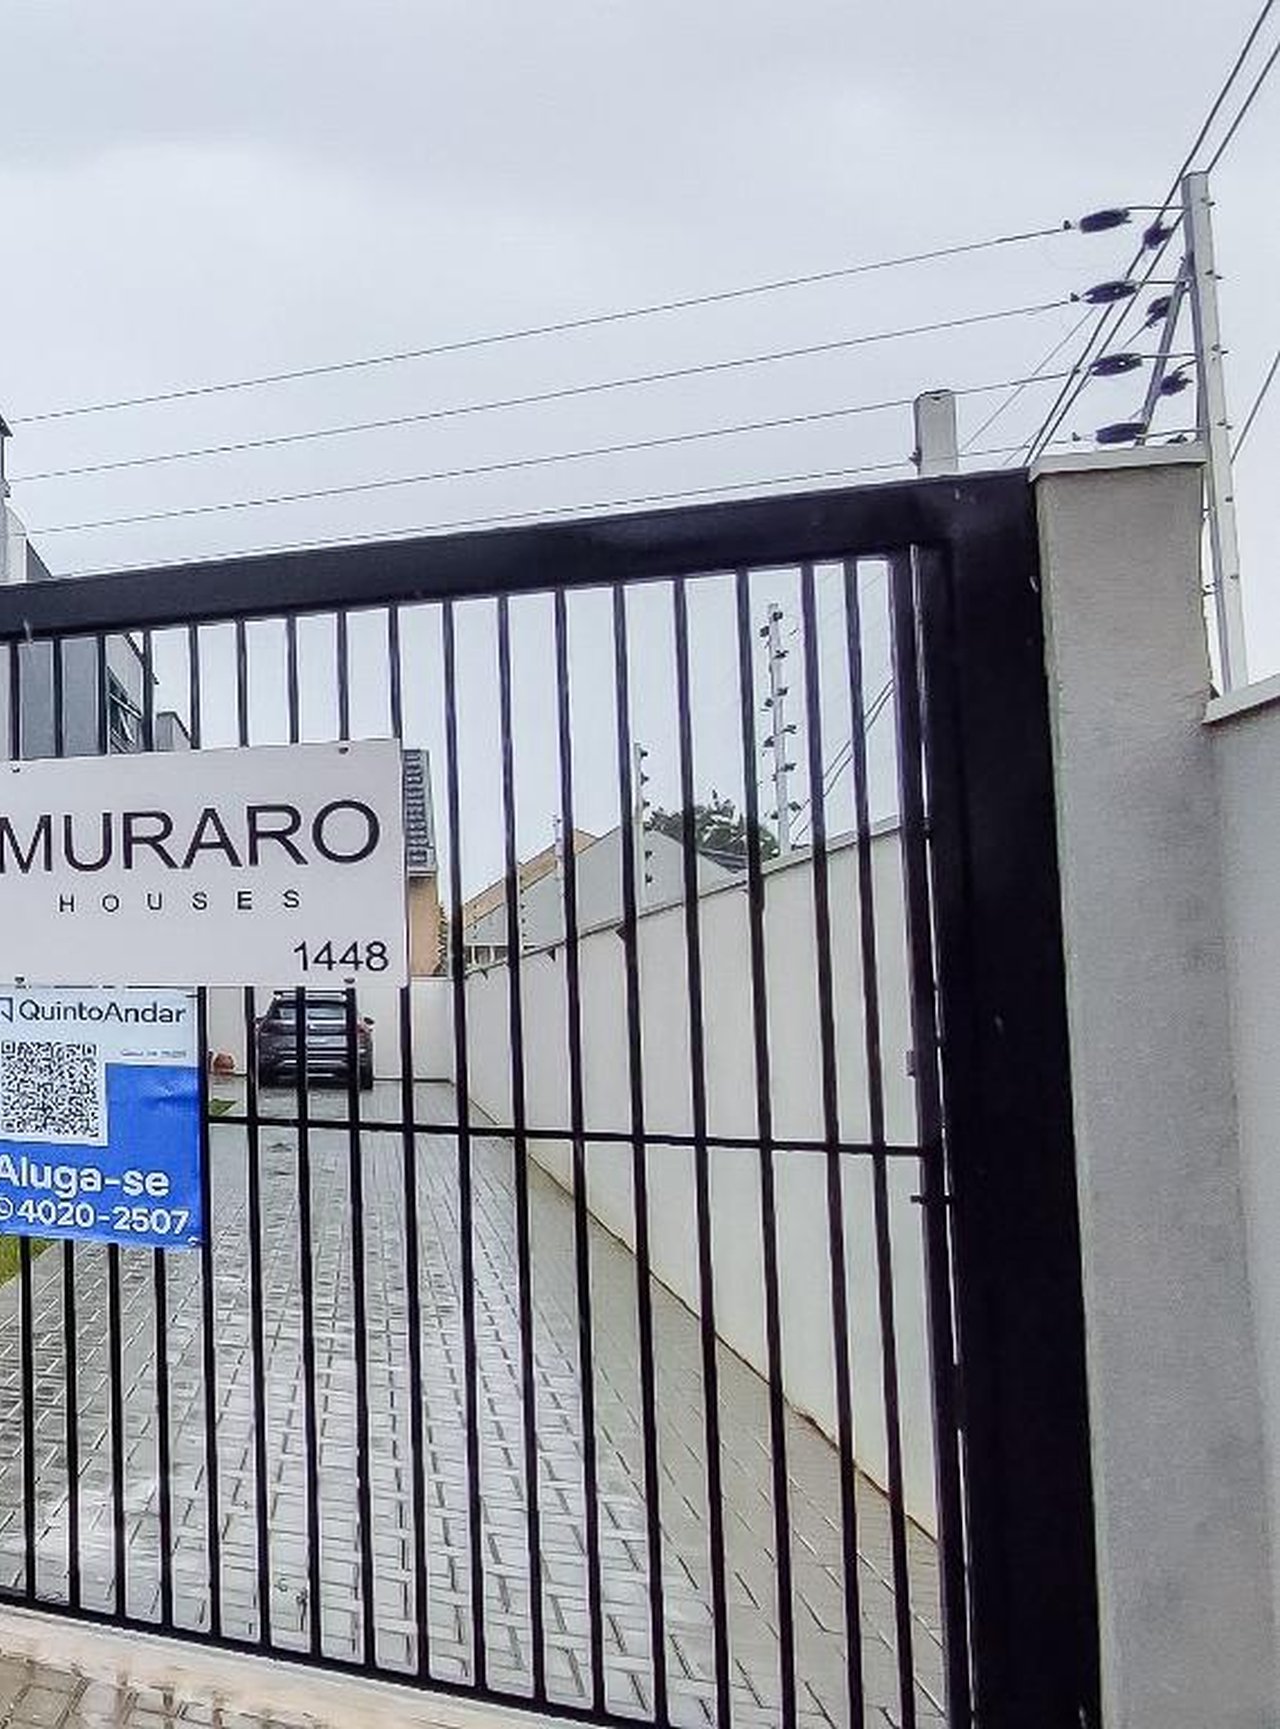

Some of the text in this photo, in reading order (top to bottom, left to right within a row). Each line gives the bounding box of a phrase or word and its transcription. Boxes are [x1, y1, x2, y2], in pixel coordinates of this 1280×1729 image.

[59, 889, 301, 914] HOUSES
[292, 941, 389, 972] 1448
[18, 999, 187, 1023] QuintoAndar
[16, 1198, 190, 1235] 4020-2507
